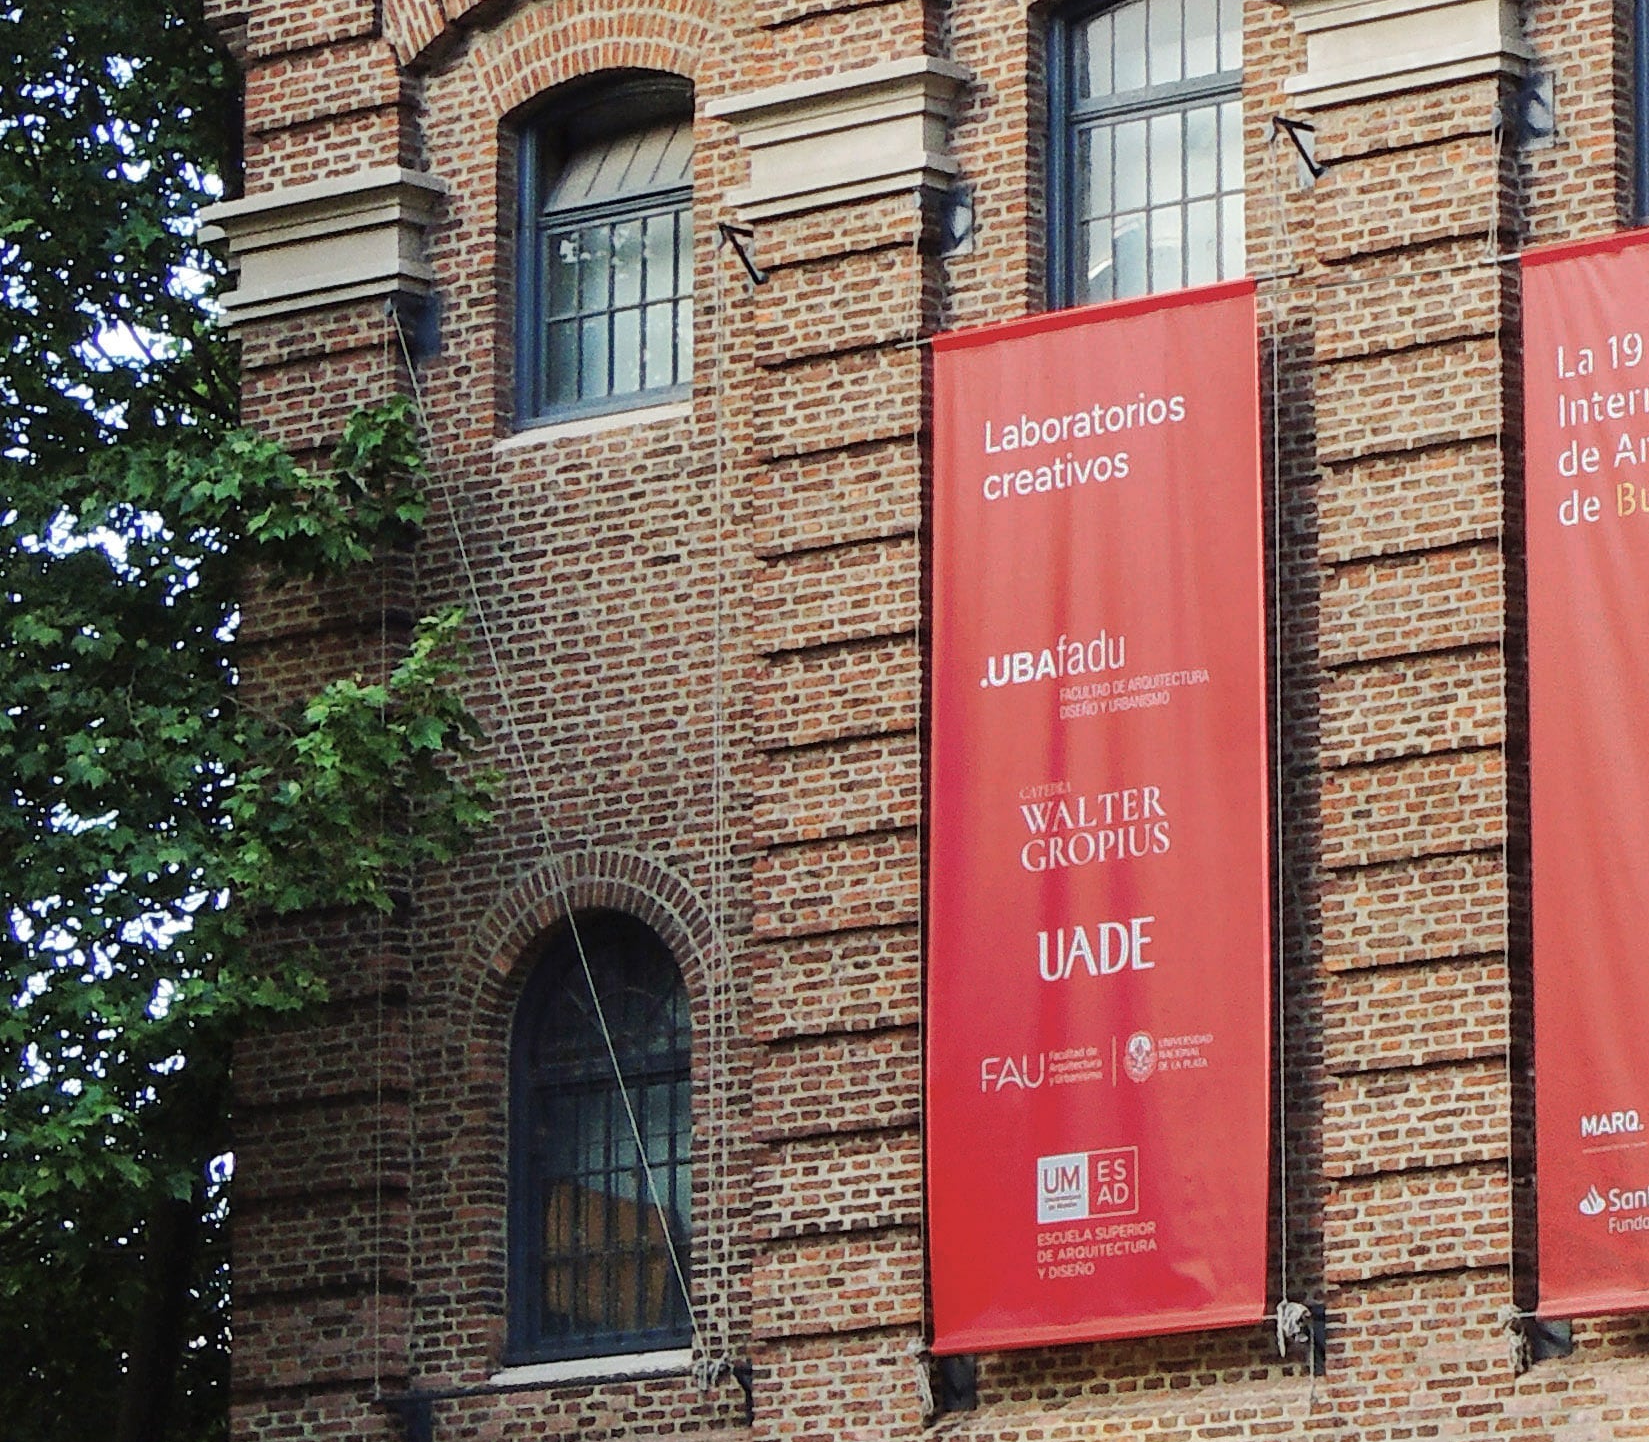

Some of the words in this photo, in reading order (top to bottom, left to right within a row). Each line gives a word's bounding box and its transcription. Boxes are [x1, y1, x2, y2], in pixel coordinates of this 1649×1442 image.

[1557, 345, 1594, 380] La
[1608, 331, 1643, 369] 19
[985, 392, 1185, 454] Laboratorios
[1558, 440, 1599, 477] de
[983, 452, 1129, 500] creativos
[1558, 490, 1600, 527] de
[1112, 679, 1125, 694] DE
[1127, 669, 1210, 691] ARQUITECTURA
[1059, 699, 1099, 720] DISEÑO
[1100, 700, 1108, 713] Y
[1109, 691, 1170, 713] URBANISMO
[1019, 785, 1167, 834] WALTER
[1020, 821, 1171, 872] GROPIUS
[1037, 916, 1156, 982] UADE
[981, 1052, 1045, 1093] FAU
[1581, 1109, 1644, 1138] MARQ.
[1043, 1164, 1080, 1194] UM
[1097, 1158, 1127, 1183] ES
[1096, 1182, 1129, 1206] AD
[1037, 1228, 1092, 1247] ESCUELA
[1094, 1221, 1156, 1240] SUPERIOR
[1037, 1249, 1054, 1263] DE
[1057, 1238, 1157, 1260] ARQUITECTURA
[1037, 1268, 1046, 1279] Y
[1048, 1261, 1096, 1279] DISEÑO
